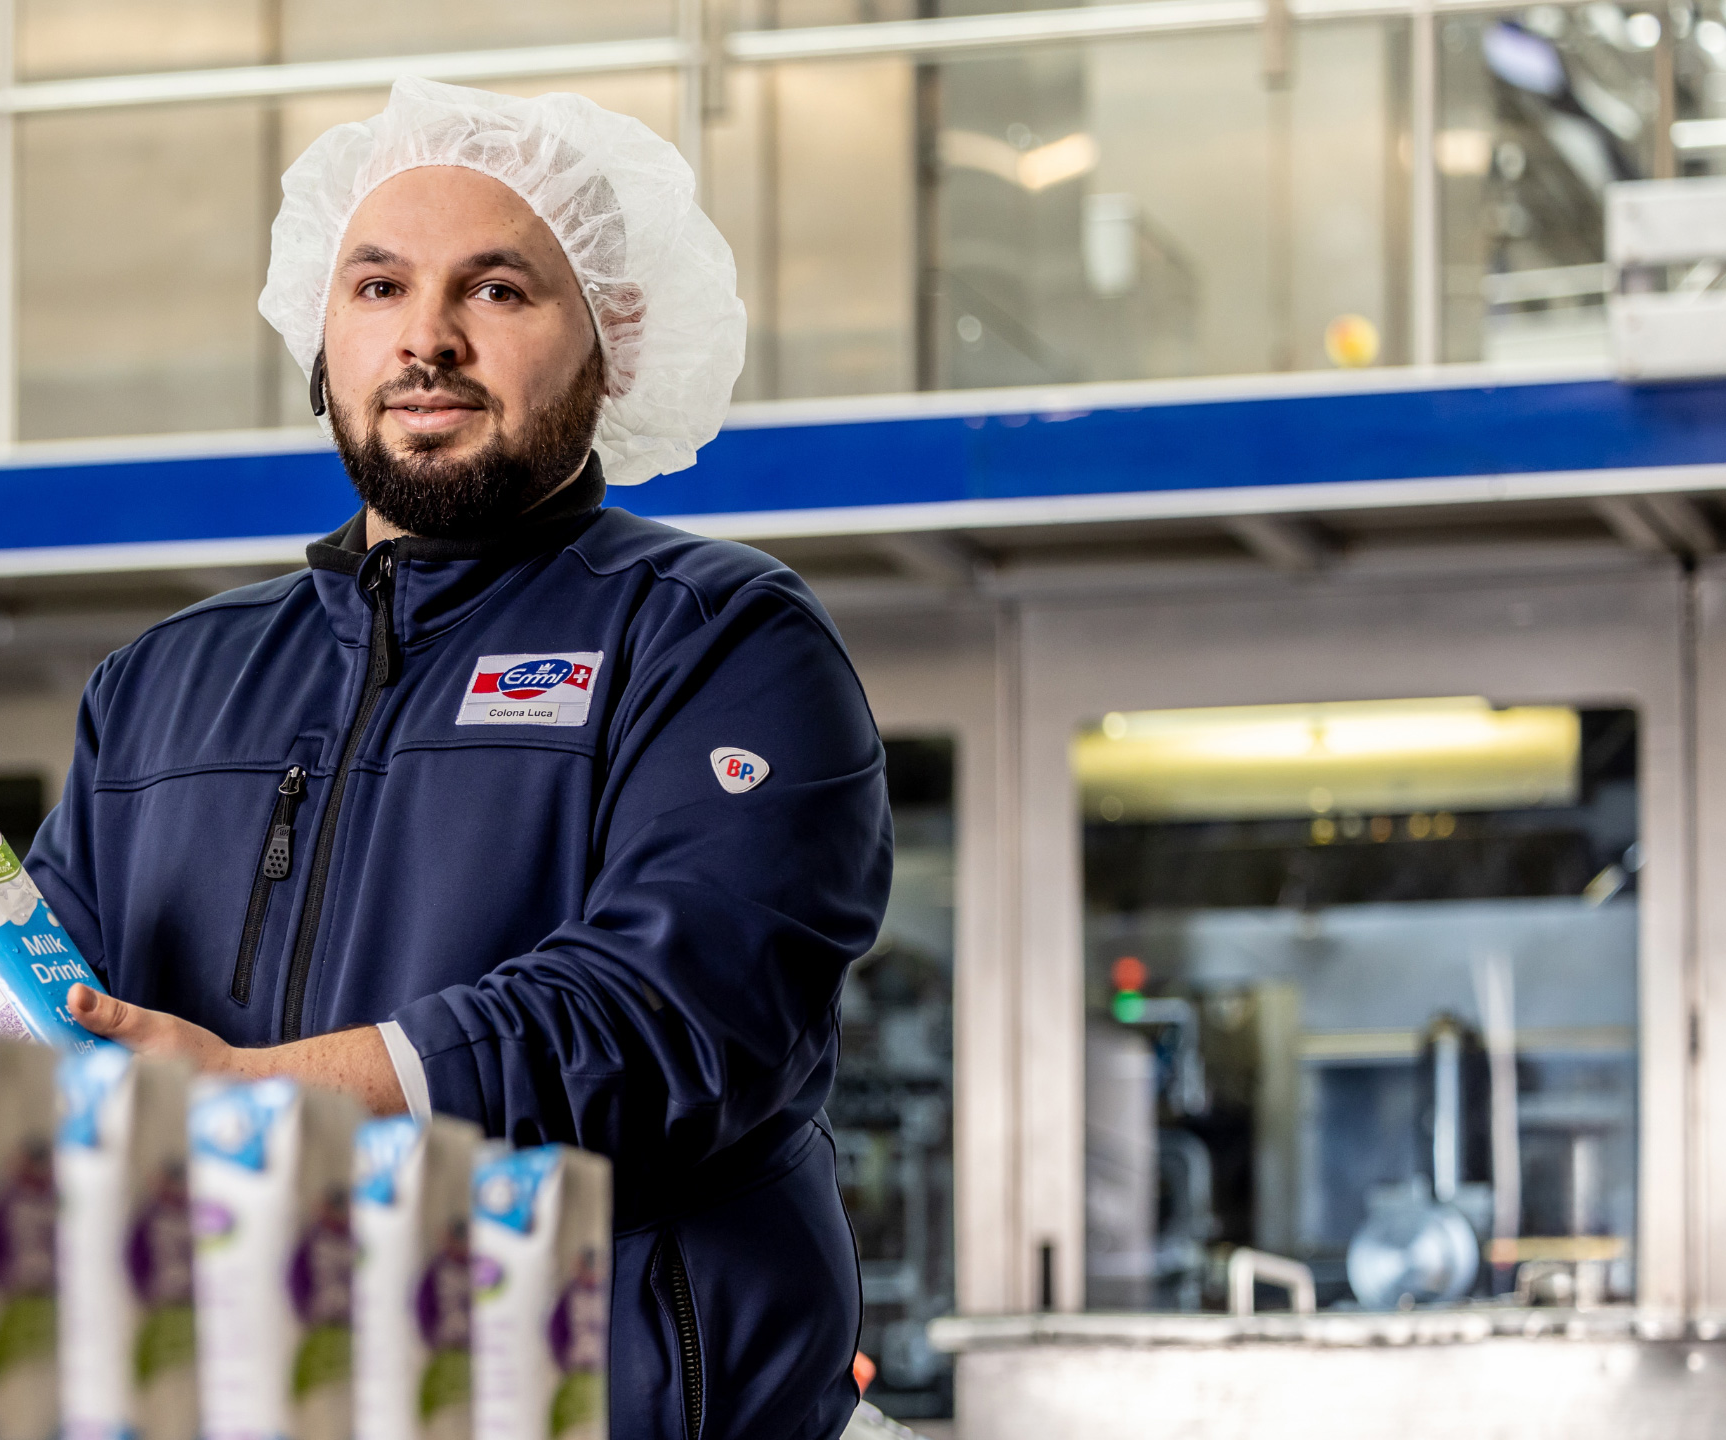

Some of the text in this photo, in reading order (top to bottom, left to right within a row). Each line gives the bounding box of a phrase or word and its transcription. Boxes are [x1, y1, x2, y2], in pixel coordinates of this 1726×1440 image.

[504, 668, 568, 684] Emmi
[489, 708, 553, 718] Colona Luca
[21, 933, 68, 956] Milk
[31, 959, 89, 984] Drink
[74, 1039, 98, 1055] UHT
